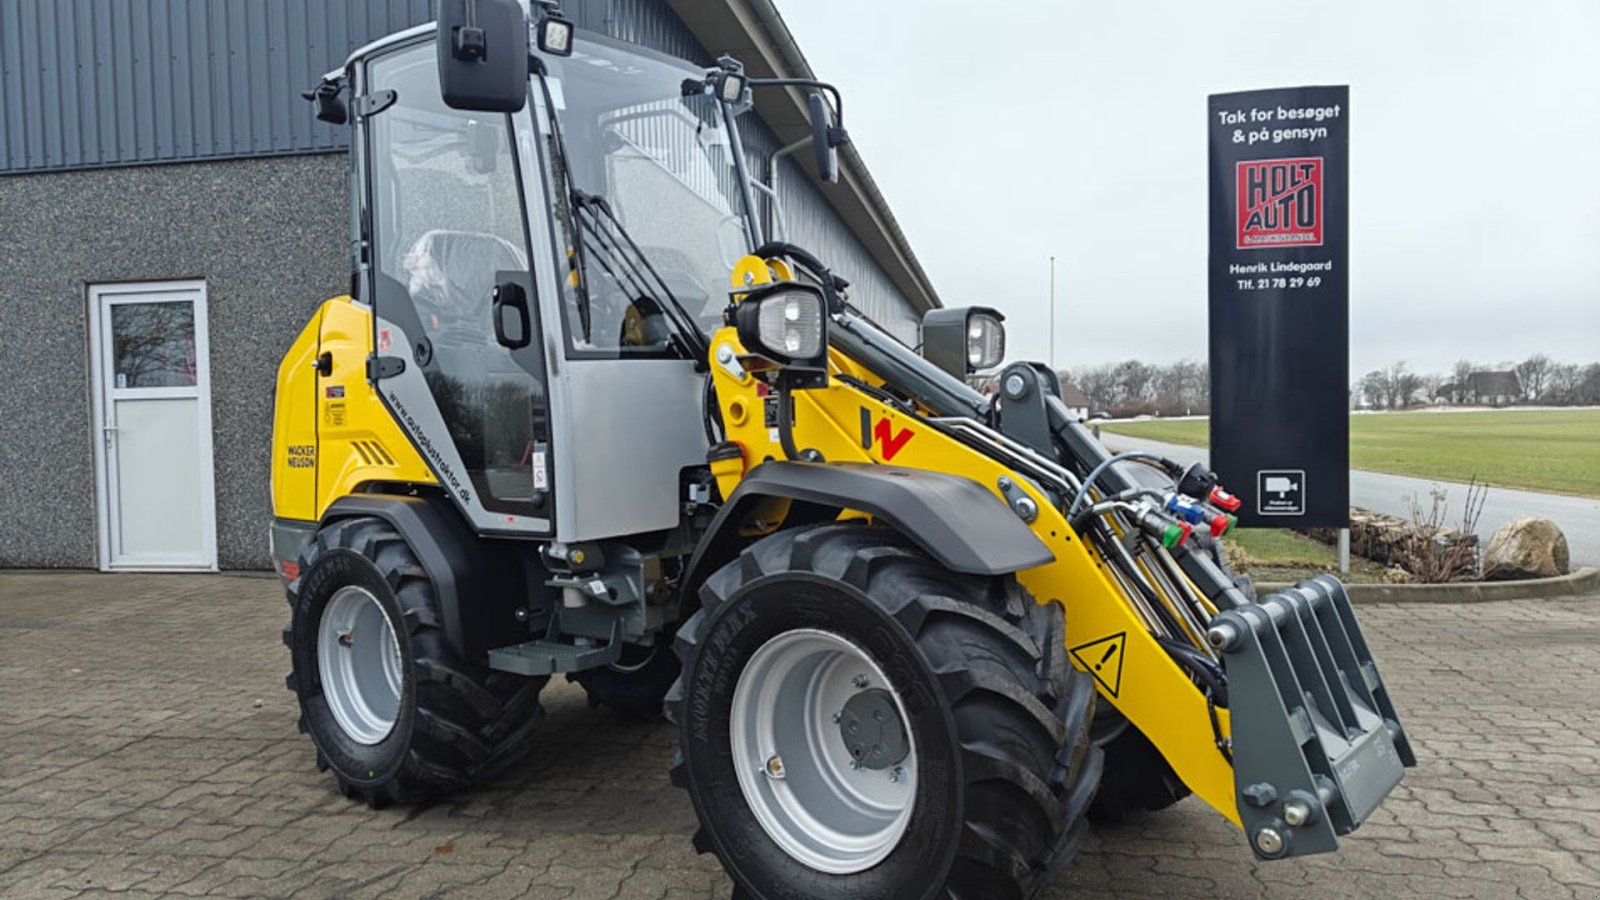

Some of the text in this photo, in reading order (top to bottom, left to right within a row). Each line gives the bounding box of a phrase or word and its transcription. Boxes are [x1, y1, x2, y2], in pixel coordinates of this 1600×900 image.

[1219, 105, 1340, 125] Tak for besøget
[1232, 127, 1327, 145] & på gensyn
[1246, 163, 1316, 212] HOLT
[1244, 182, 1316, 231] AUTO
[1229, 260, 1332, 274] Henrik Lindegaard
[1237, 277, 1321, 290] Tlf. 21 78 29 69
[288, 445, 315, 456] WACKER
[389, 390, 471, 505] www.autoplustraktor.dk
[288, 457, 315, 468] NEUSON
